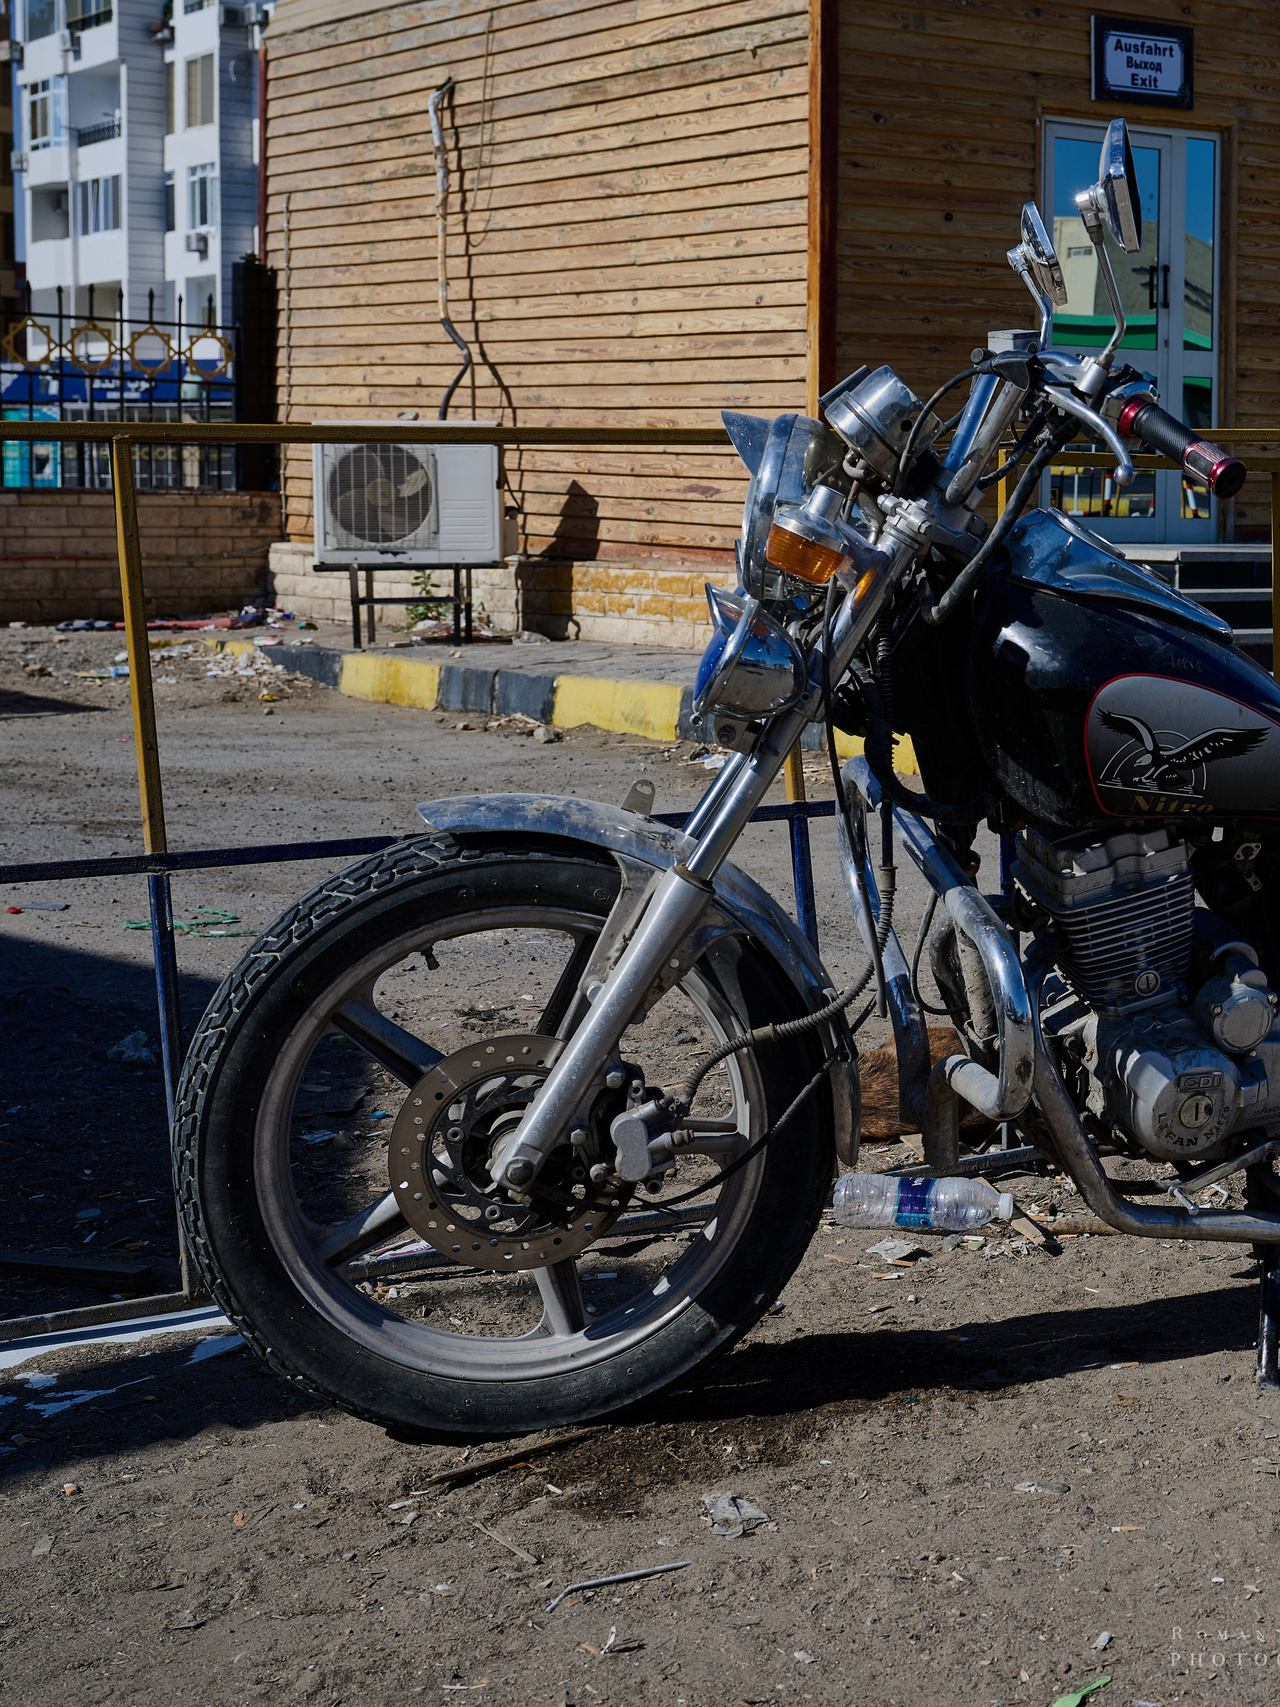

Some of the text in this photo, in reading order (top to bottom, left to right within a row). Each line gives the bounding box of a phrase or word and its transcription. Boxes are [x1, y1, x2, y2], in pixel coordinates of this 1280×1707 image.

[1114, 38, 1174, 58] Ausfahrt
[1126, 56, 1162, 74] Выход
[1131, 73, 1158, 88] Exit
[1131, 795, 1214, 815] Nitro
[1183, 1074, 1223, 1089] CDI
[1158, 1112, 1199, 1147] LIFAN
